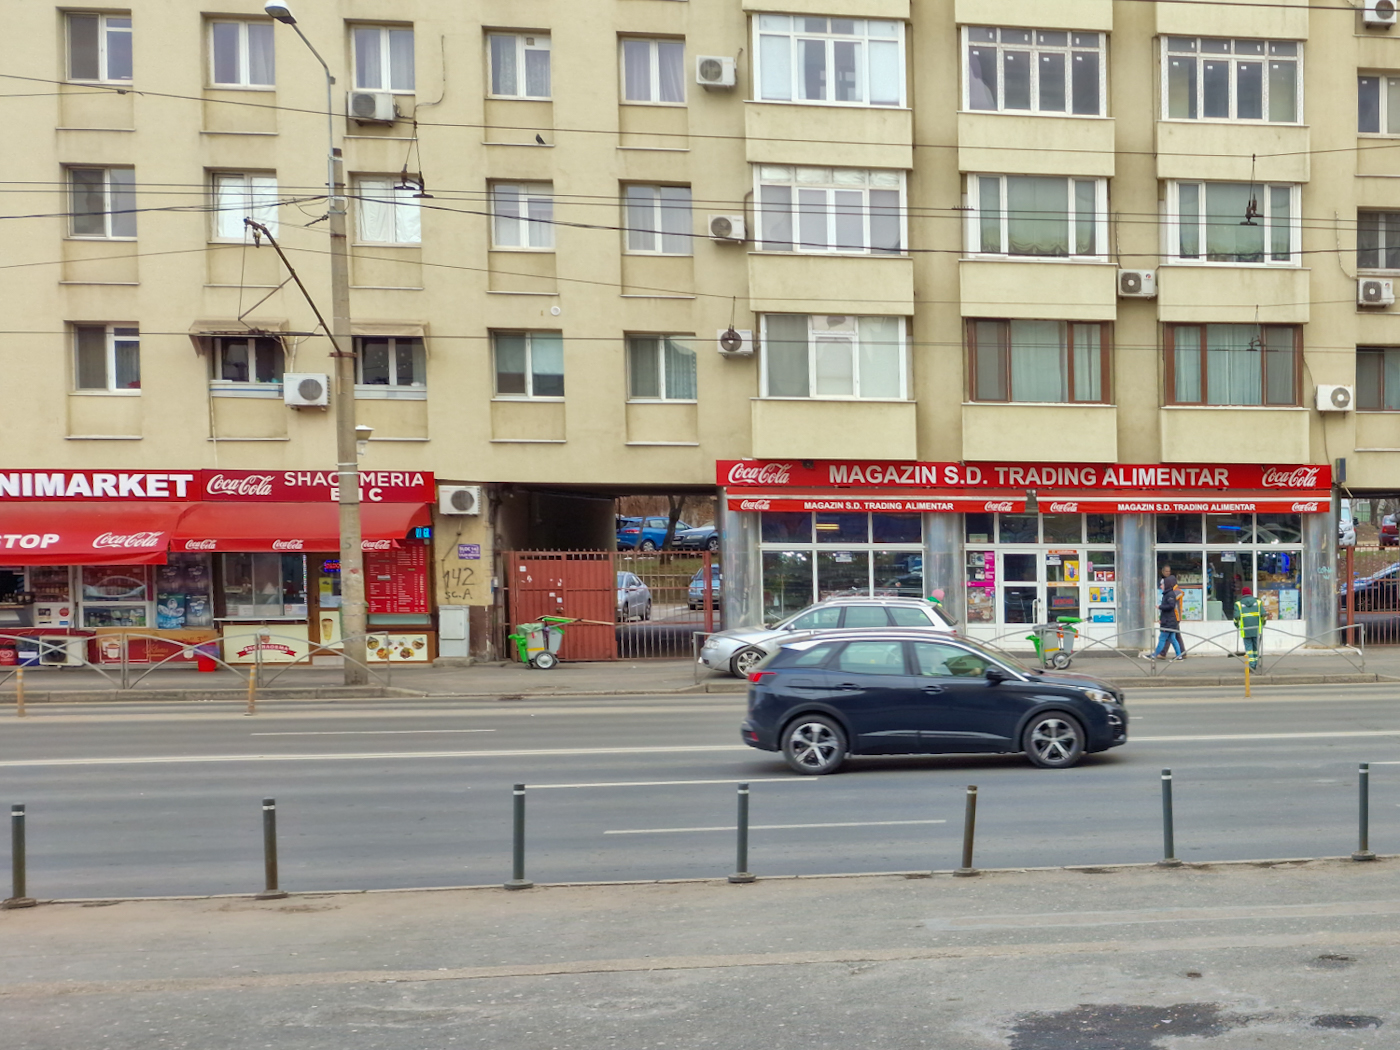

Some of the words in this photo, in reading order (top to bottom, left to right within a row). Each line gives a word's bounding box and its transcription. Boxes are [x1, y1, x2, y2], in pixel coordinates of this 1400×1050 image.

[728, 462, 792, 484] Coca-Cola
[829, 465, 937, 484] MAGAZIN
[944, 466, 988, 485] S.D.
[995, 467, 1097, 486] TRADING
[1102, 467, 1230, 487] ALIMENTAR
[1262, 466, 1320, 488] Coca-Cola
[206, 474, 275, 495] Coca-Cola
[740, 500, 771, 511] Coca-Cola
[804, 502, 844, 511] MAGAZIN
[845, 502, 863, 511] S.D.
[864, 502, 902, 511] TRADING
[905, 502, 954, 511] ALIMENTAR
[984, 501, 1013, 512] Coca-Cola
[1049, 501, 1078, 513] Coca-Cola
[1118, 503, 1155, 512] MAGAZIN
[1156, 503, 1172, 512] S.D.
[1173, 503, 1209, 512] TRADING
[1210, 503, 1256, 512] ALIMENTAR
[1291, 501, 1319, 512] Coca-Cola
[92, 531, 164, 549] Coca-Cola
[184, 539, 217, 550] Coca-Cola
[272, 539, 304, 550] Coca-Cola
[443, 567, 475, 588] 142
